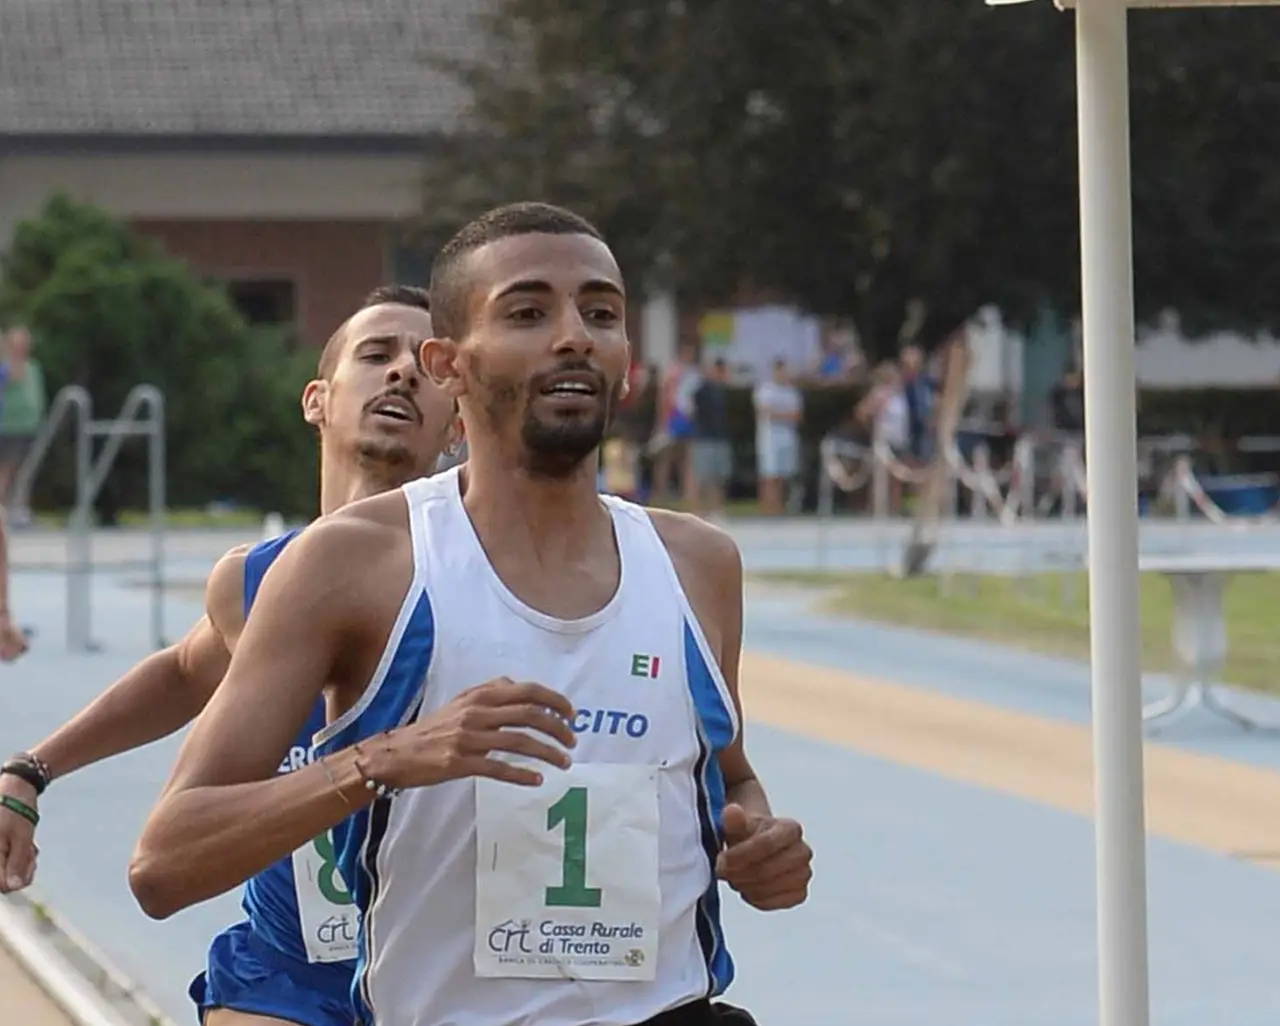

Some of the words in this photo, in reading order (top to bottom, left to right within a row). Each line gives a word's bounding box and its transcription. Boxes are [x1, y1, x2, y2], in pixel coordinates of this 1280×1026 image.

[544, 786, 602, 908] 1
[539, 919, 585, 938] Cassa
[590, 922, 643, 939] Rurale
[539, 938, 554, 954] di
[560, 938, 610, 955] Trento
